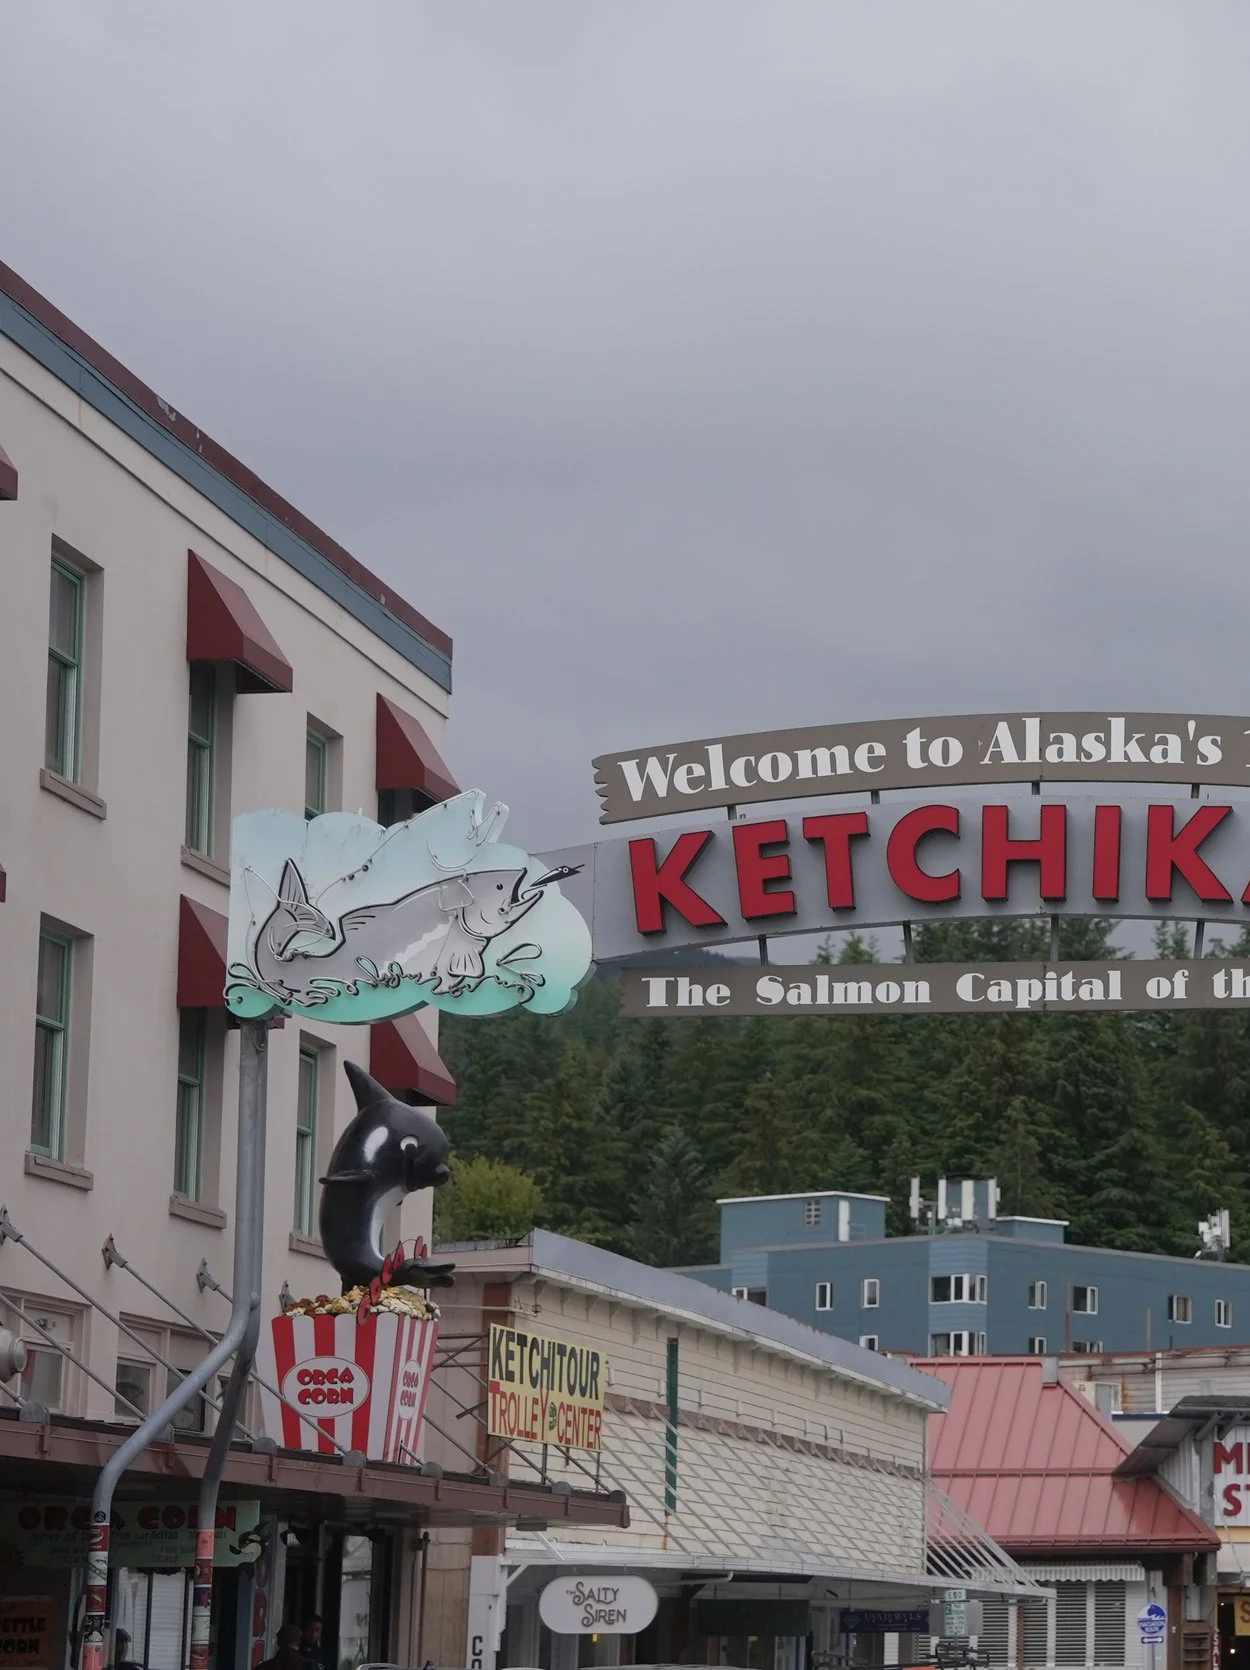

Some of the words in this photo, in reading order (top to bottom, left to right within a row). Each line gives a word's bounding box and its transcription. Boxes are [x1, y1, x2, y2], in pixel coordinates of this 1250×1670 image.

[616, 743, 887, 803] Welcome
[903, 727, 964, 768] to
[980, 717, 1223, 766] Alaska's
[641, 977, 731, 1008] The
[756, 975, 931, 1006] Salmon
[956, 970, 1122, 1009] Capital
[1145, 969, 1190, 999] of
[297, 1367, 354, 1385] ORCA
[491, 1326, 600, 1401] KETCHITOUR
[402, 1371, 418, 1388] ORCA
[297, 1387, 354, 1405] CORN
[400, 1389, 417, 1408] CORN
[489, 1380, 550, 1440] TROLLEY
[557, 1401, 602, 1453] CENTER
[138, 1505, 237, 1532] CON
[572, 1581, 620, 1606] SALTY
[581, 1603, 627, 1628] SIREN
